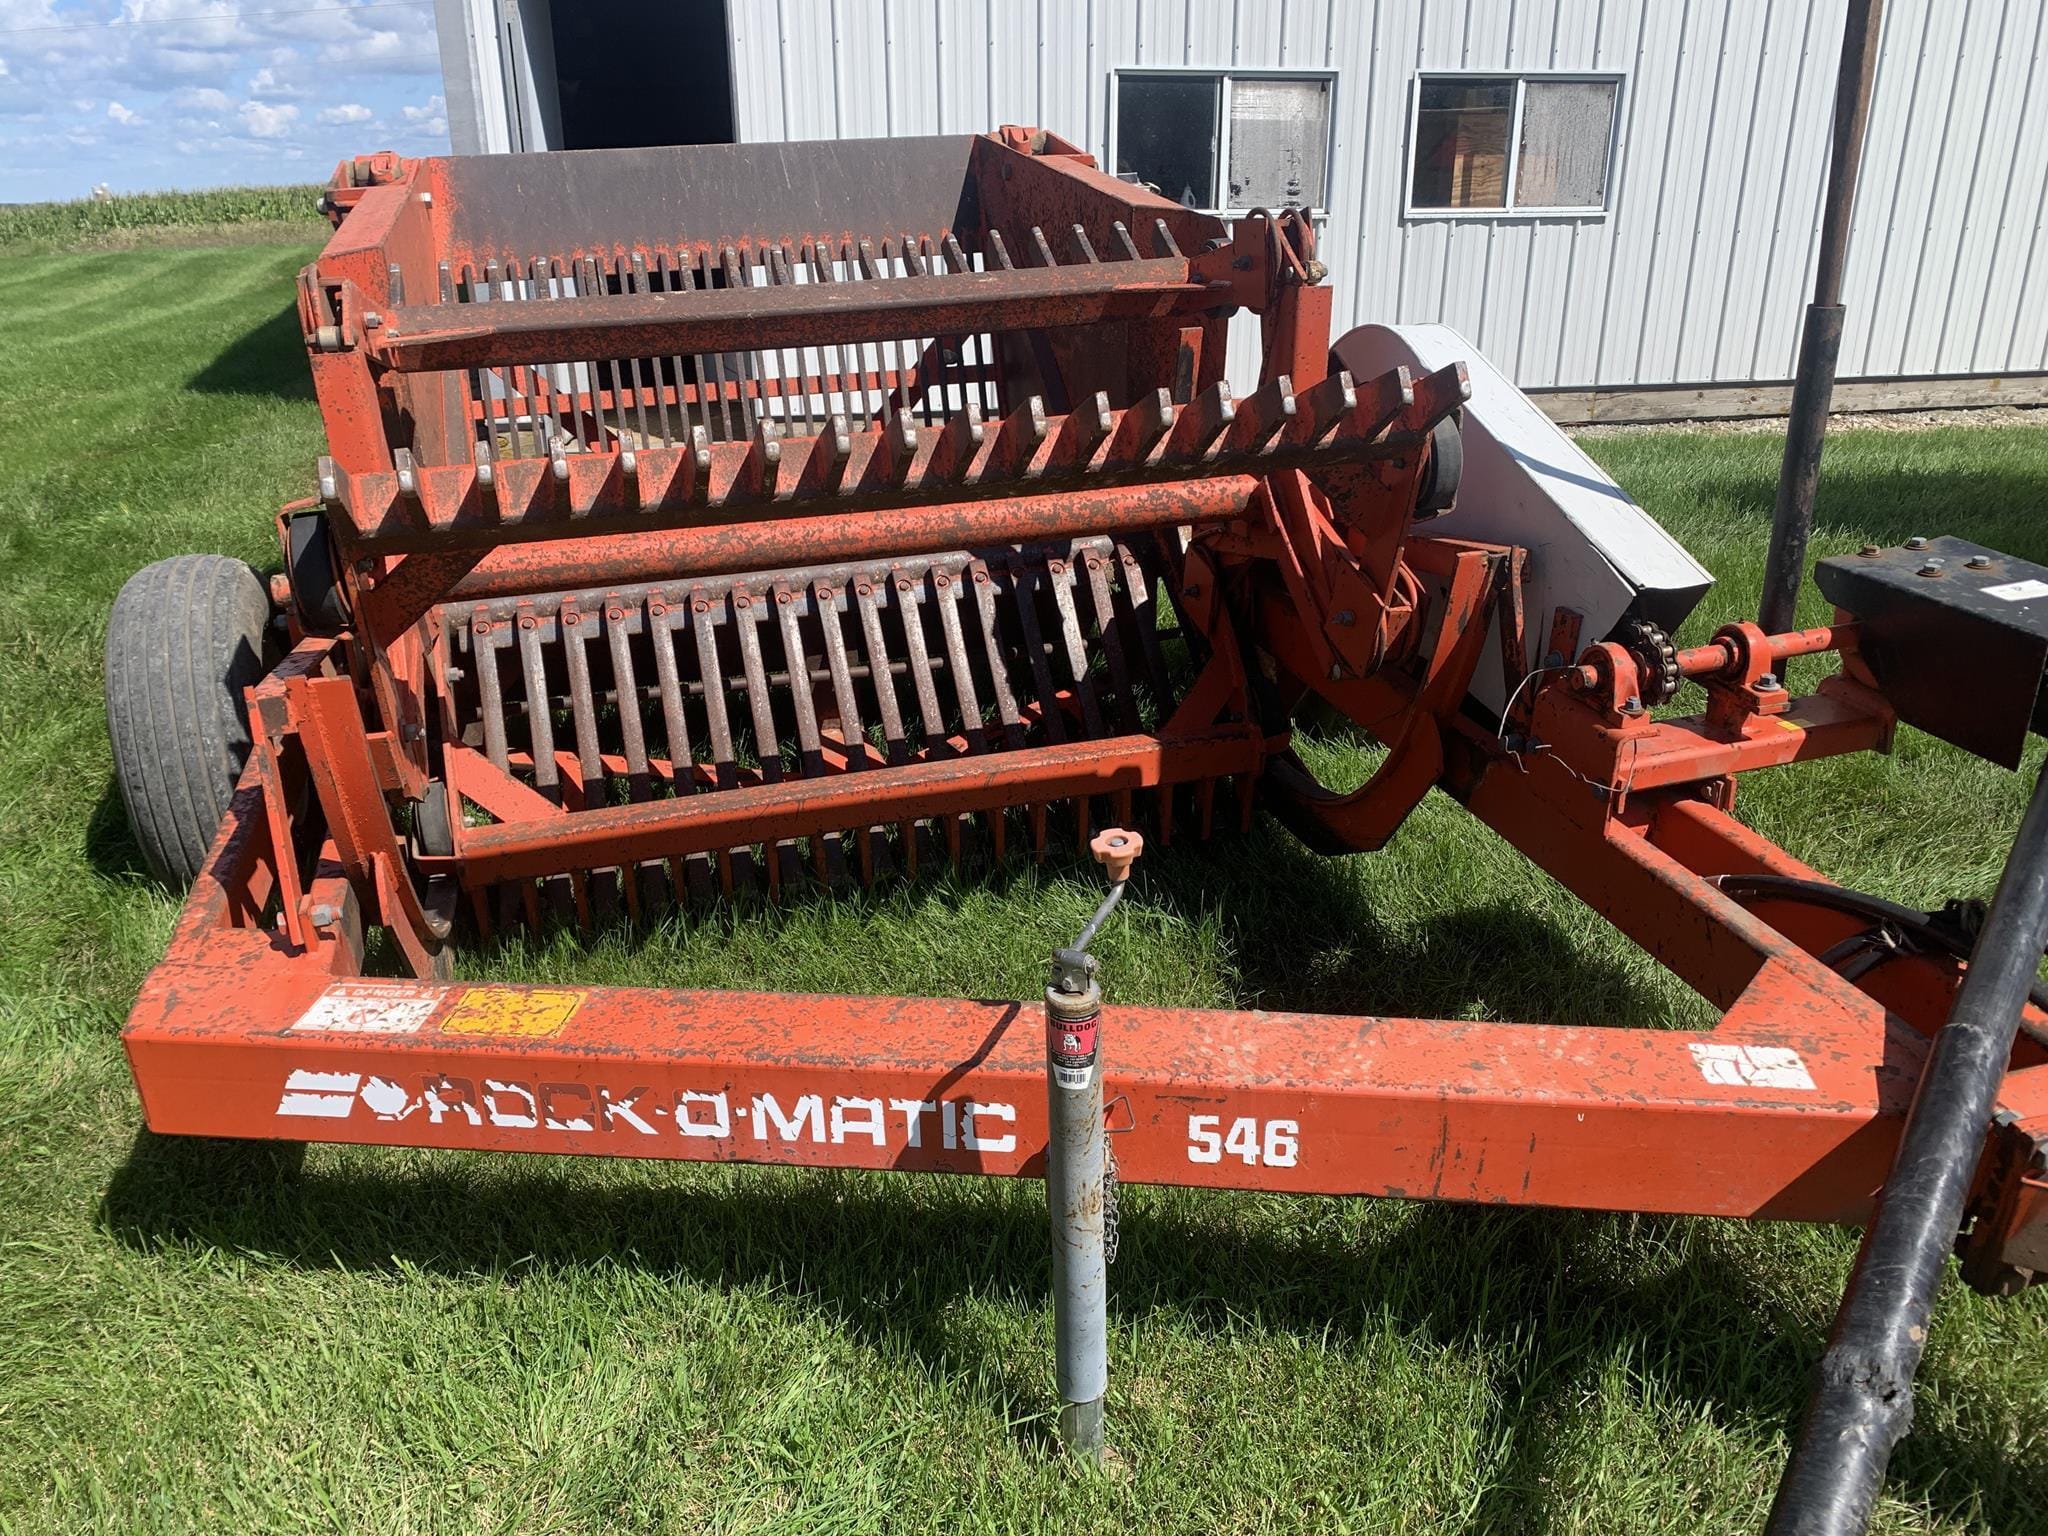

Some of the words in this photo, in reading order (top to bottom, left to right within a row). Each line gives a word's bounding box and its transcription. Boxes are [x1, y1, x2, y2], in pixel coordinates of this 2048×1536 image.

[351, 988, 416, 998] DANGER
[1050, 1019, 1097, 1032] BULLDOG
[1187, 1115, 1299, 1167] 546
